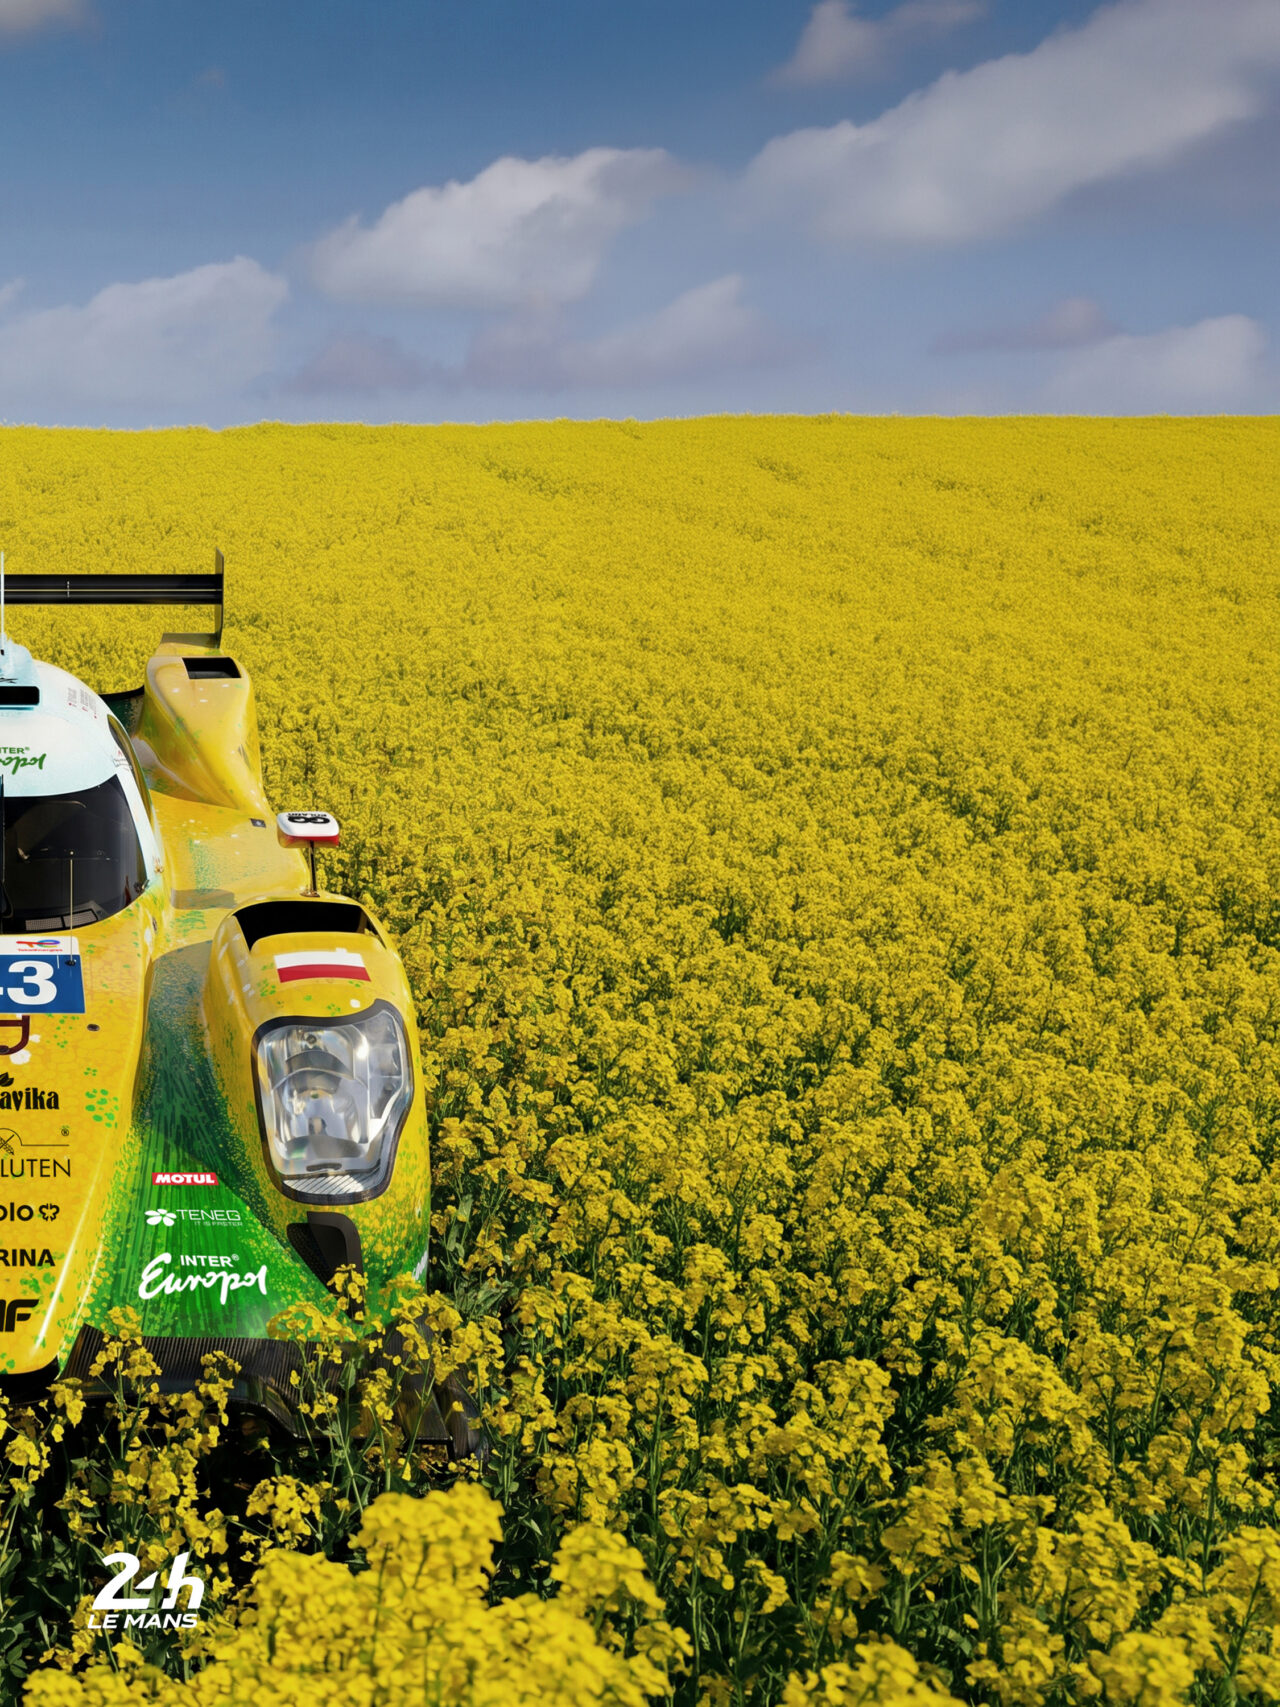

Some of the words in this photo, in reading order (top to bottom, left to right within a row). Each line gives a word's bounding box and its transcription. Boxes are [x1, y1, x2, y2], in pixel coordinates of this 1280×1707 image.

[155, 1173, 215, 1184] MOTUL
[175, 1209, 241, 1221] TENEG
[138, 1252, 268, 1305] Europol
